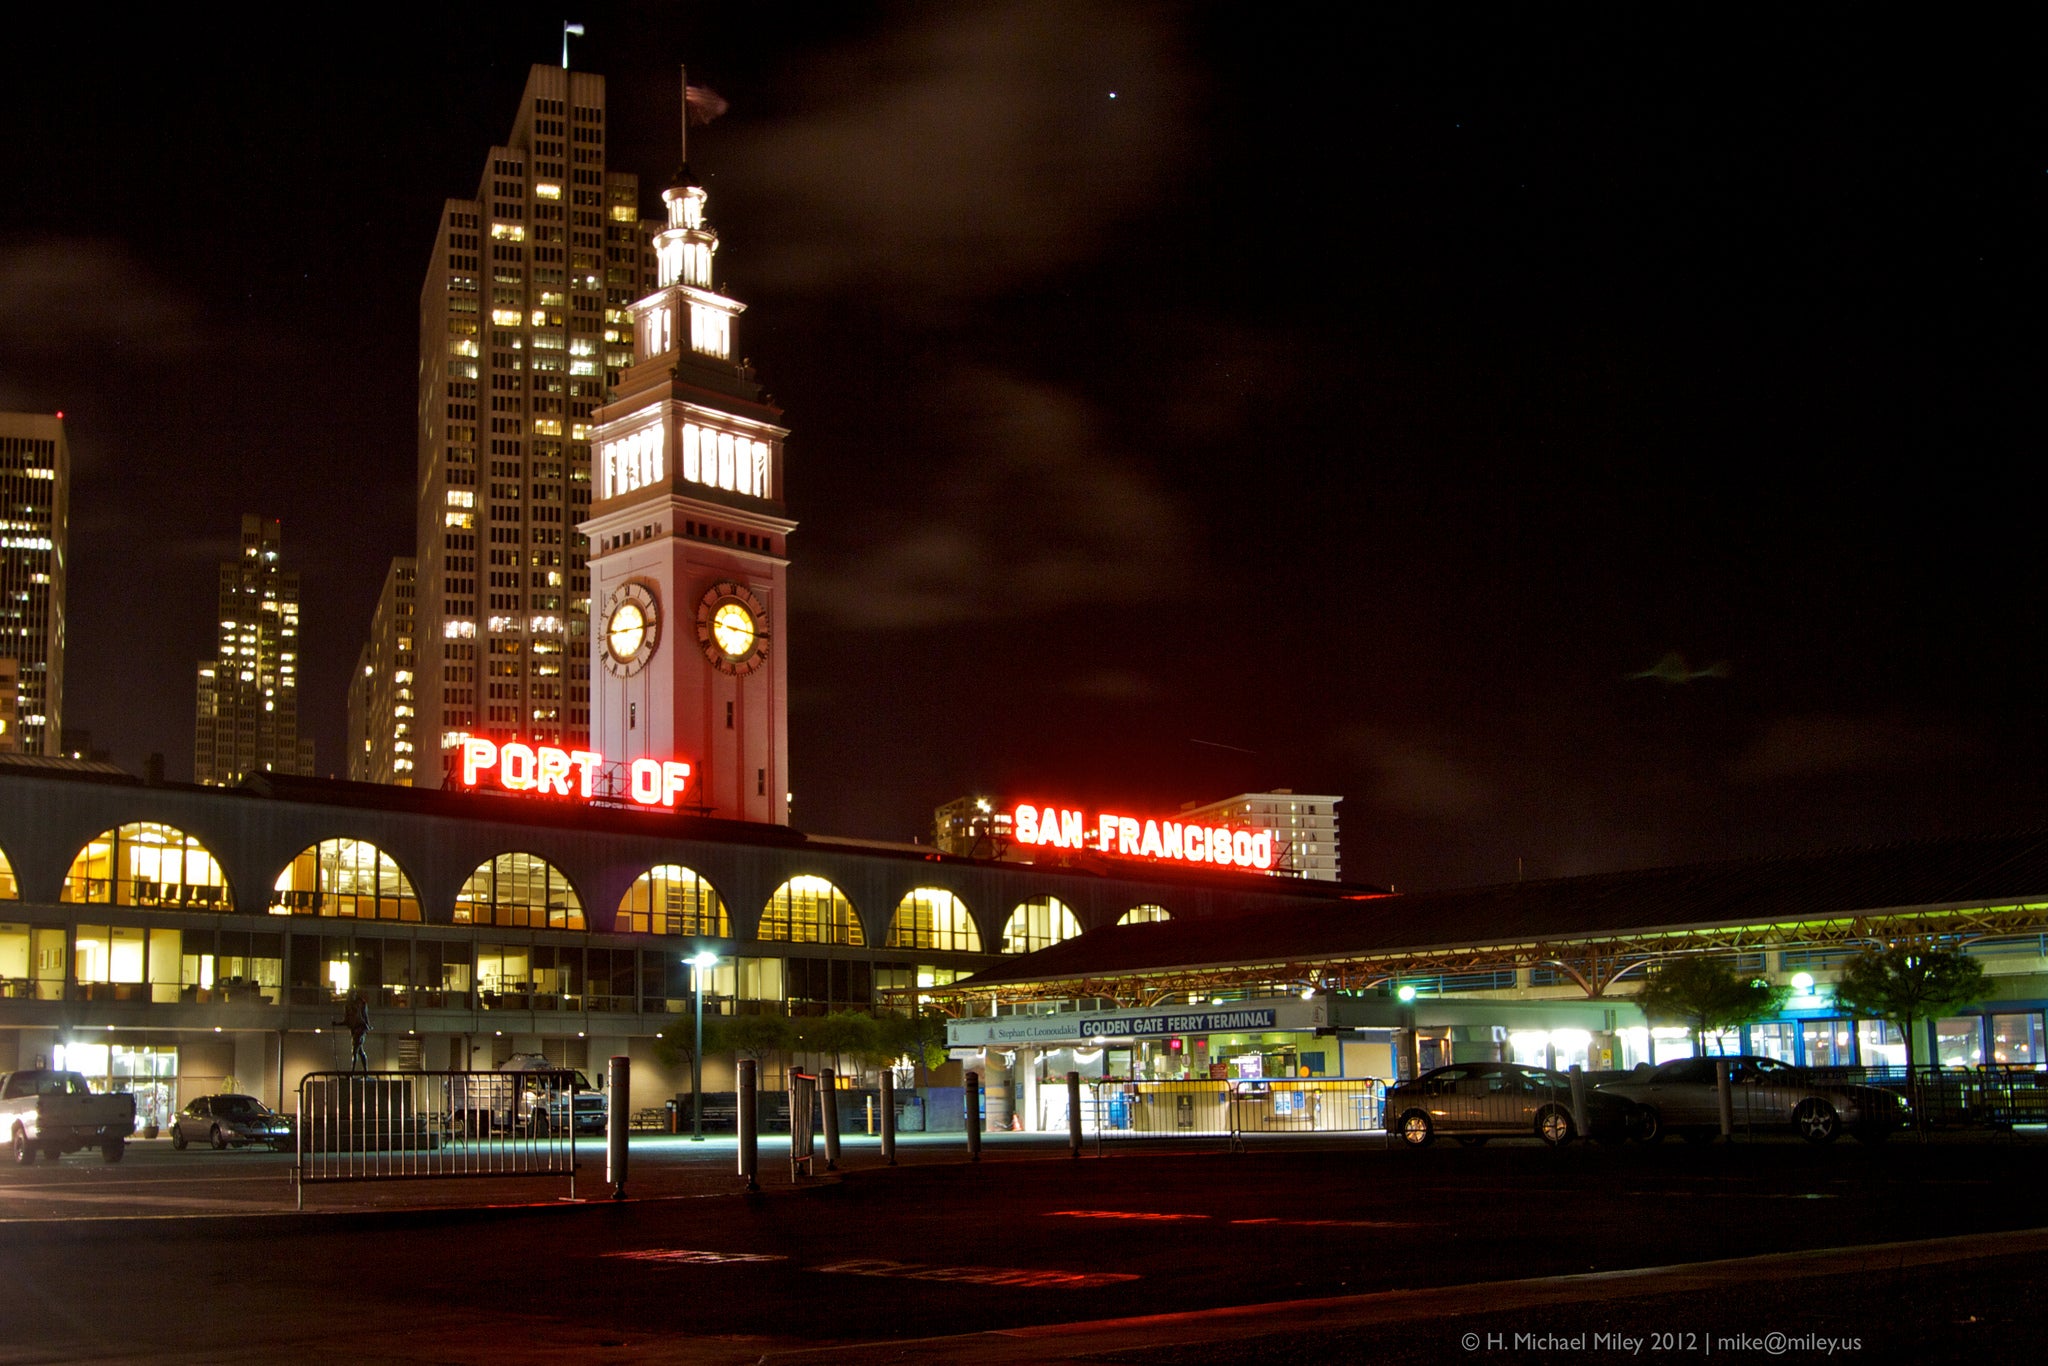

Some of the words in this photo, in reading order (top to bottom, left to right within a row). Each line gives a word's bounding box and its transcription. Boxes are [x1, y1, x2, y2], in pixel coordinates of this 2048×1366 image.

[464, 738, 602, 797] PORT
[631, 758, 690, 806] OF
[1015, 804, 1082, 848] SAN
[998, 1028, 1026, 1040] Stephan
[1083, 1020, 1131, 1036] GOLDEN
[1133, 1018, 1163, 1033] GATE
[1168, 1015, 1203, 1031] FERRY
[1207, 1011, 1270, 1028] TERMINAL
